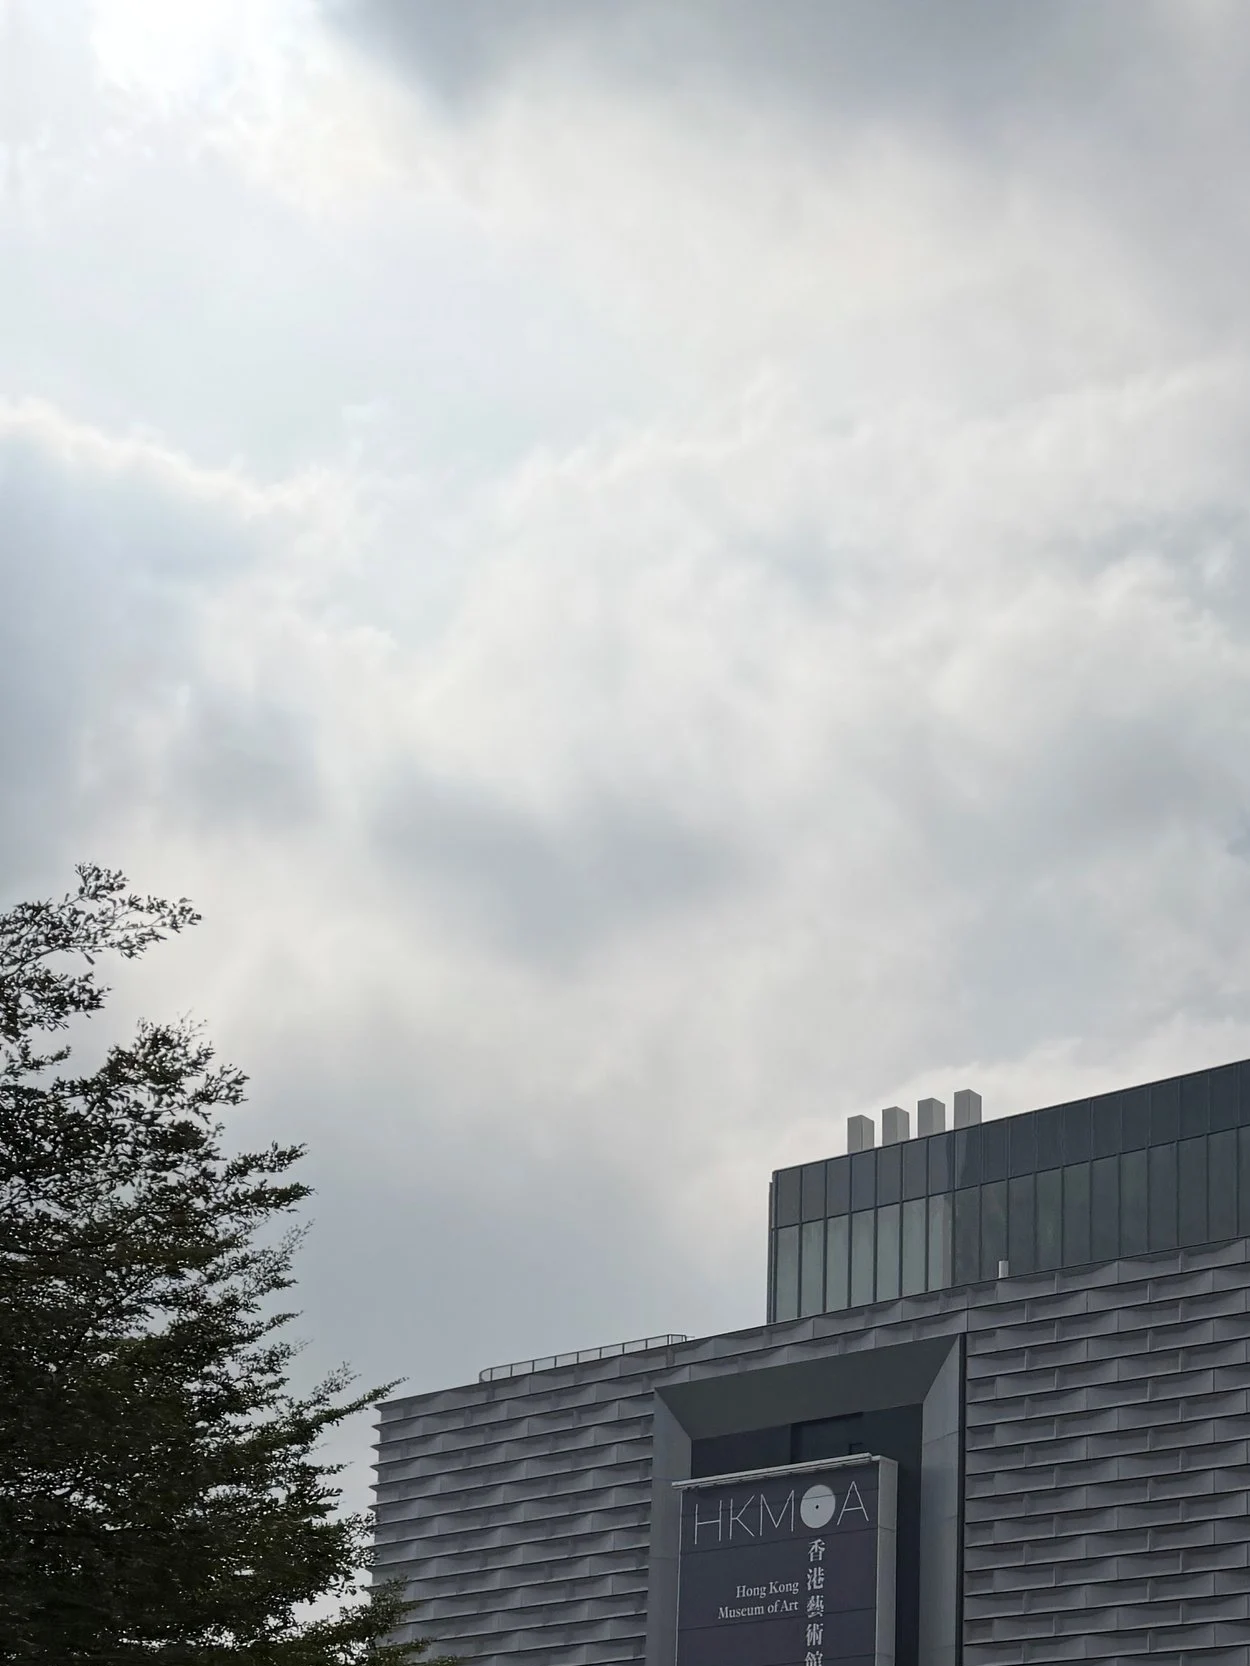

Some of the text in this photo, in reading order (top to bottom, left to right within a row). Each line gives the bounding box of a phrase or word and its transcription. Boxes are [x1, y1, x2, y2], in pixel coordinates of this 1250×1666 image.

[694, 1481, 870, 1545] HKMOA
[736, 1581, 799, 1599] Hong Kong
[718, 1600, 799, 1619] Museum of Art
